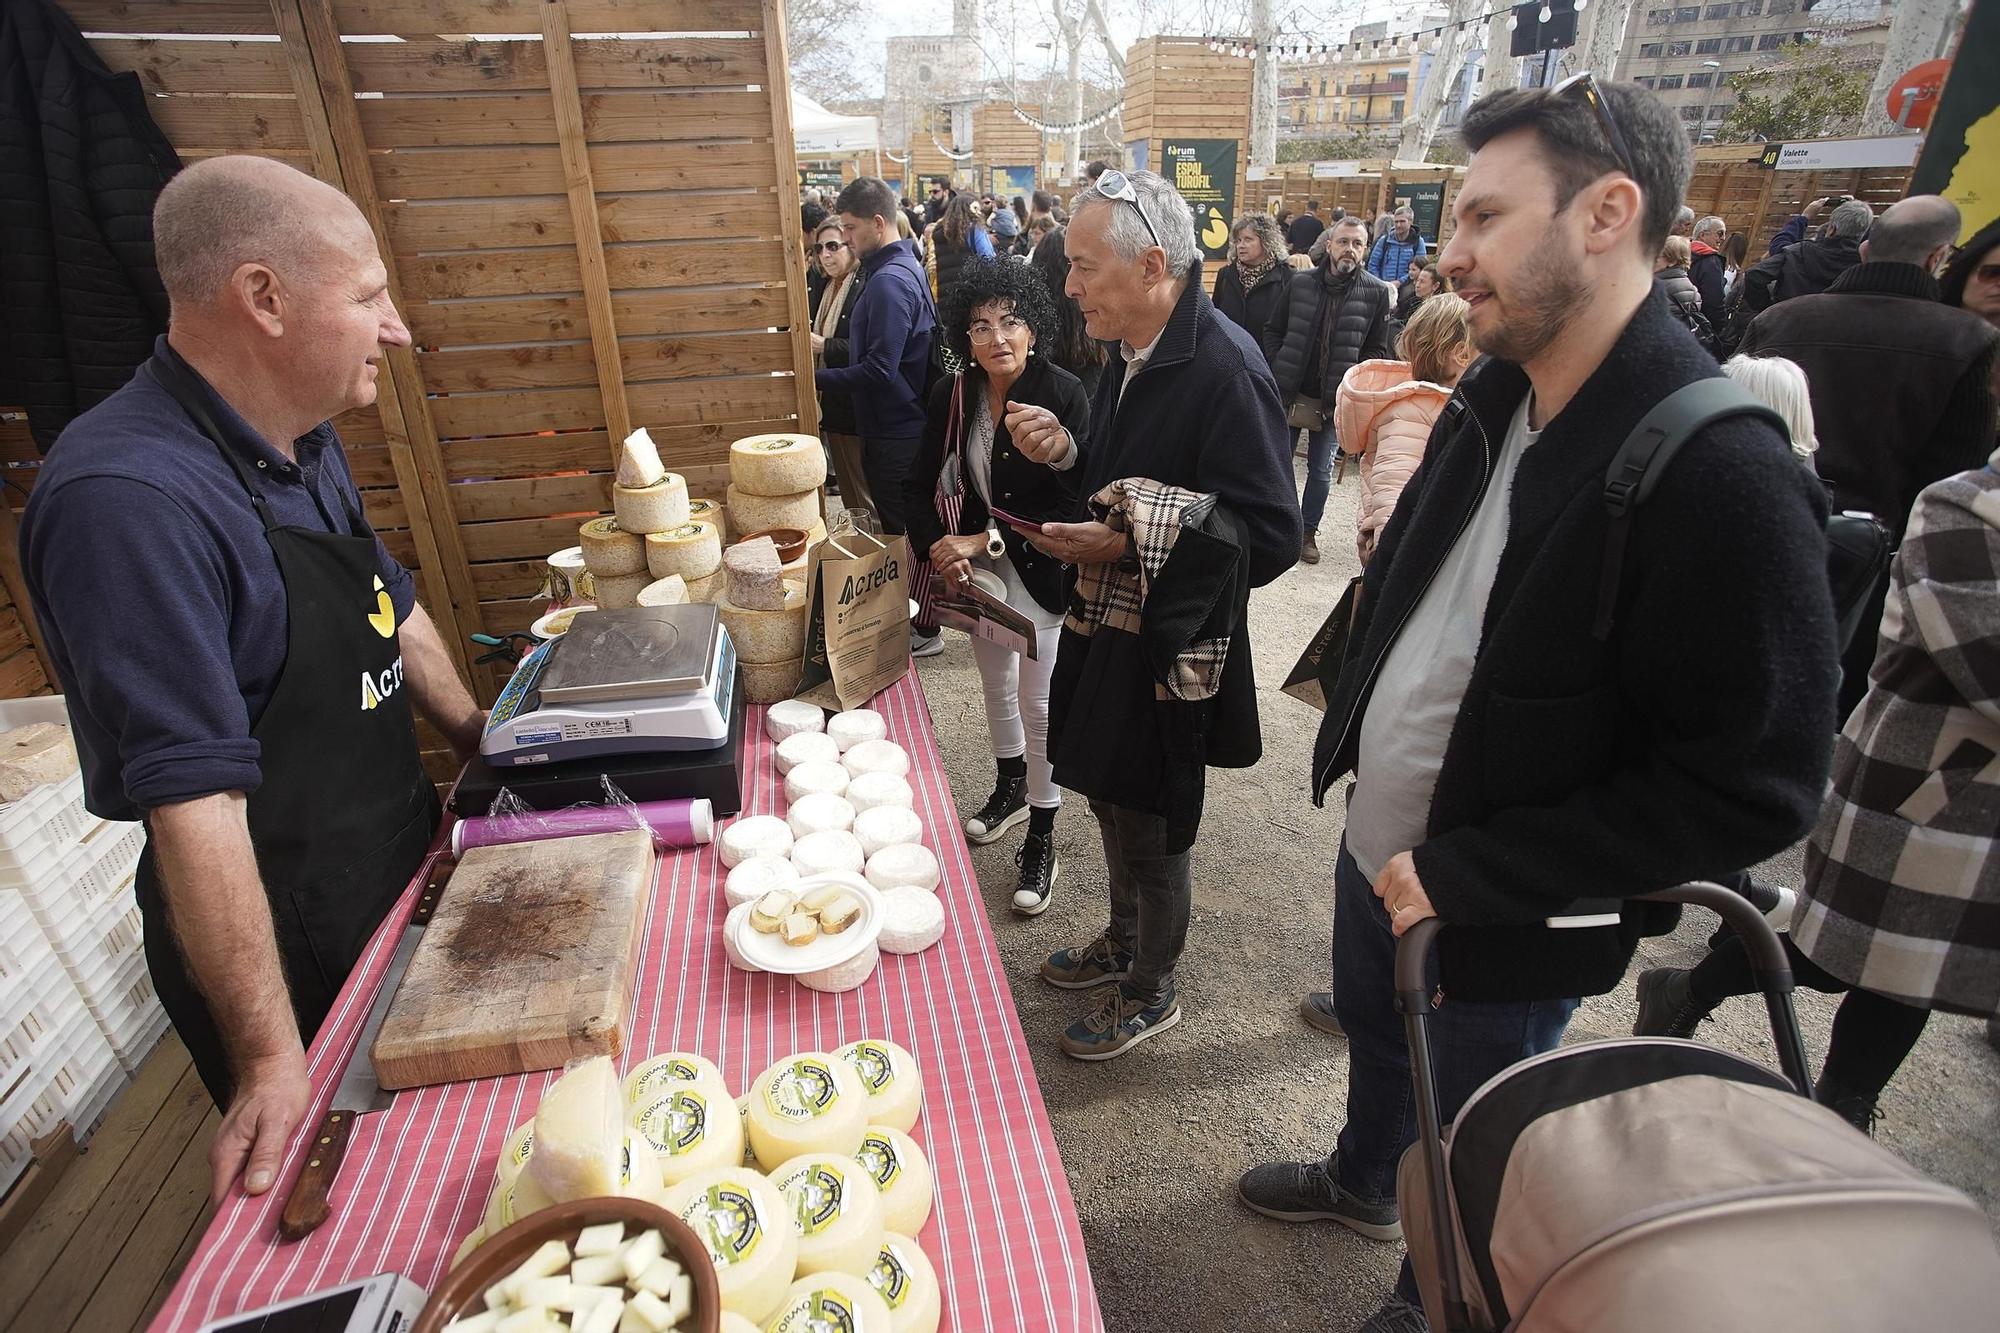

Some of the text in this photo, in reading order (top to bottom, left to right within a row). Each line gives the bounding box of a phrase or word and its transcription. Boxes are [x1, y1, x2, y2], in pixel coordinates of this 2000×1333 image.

[1176, 162, 1201, 175] ESPAI
[1763, 152, 1776, 165] 40
[838, 556, 899, 605] Acrefa
[360, 656, 403, 711] Acr
[639, 1064, 668, 1086] TORMO
[770, 1067, 795, 1095] TORMO
[640, 1096, 674, 1123] TORMO
[780, 1104, 809, 1117] SERRA
[778, 1169, 809, 1192] ORMO
